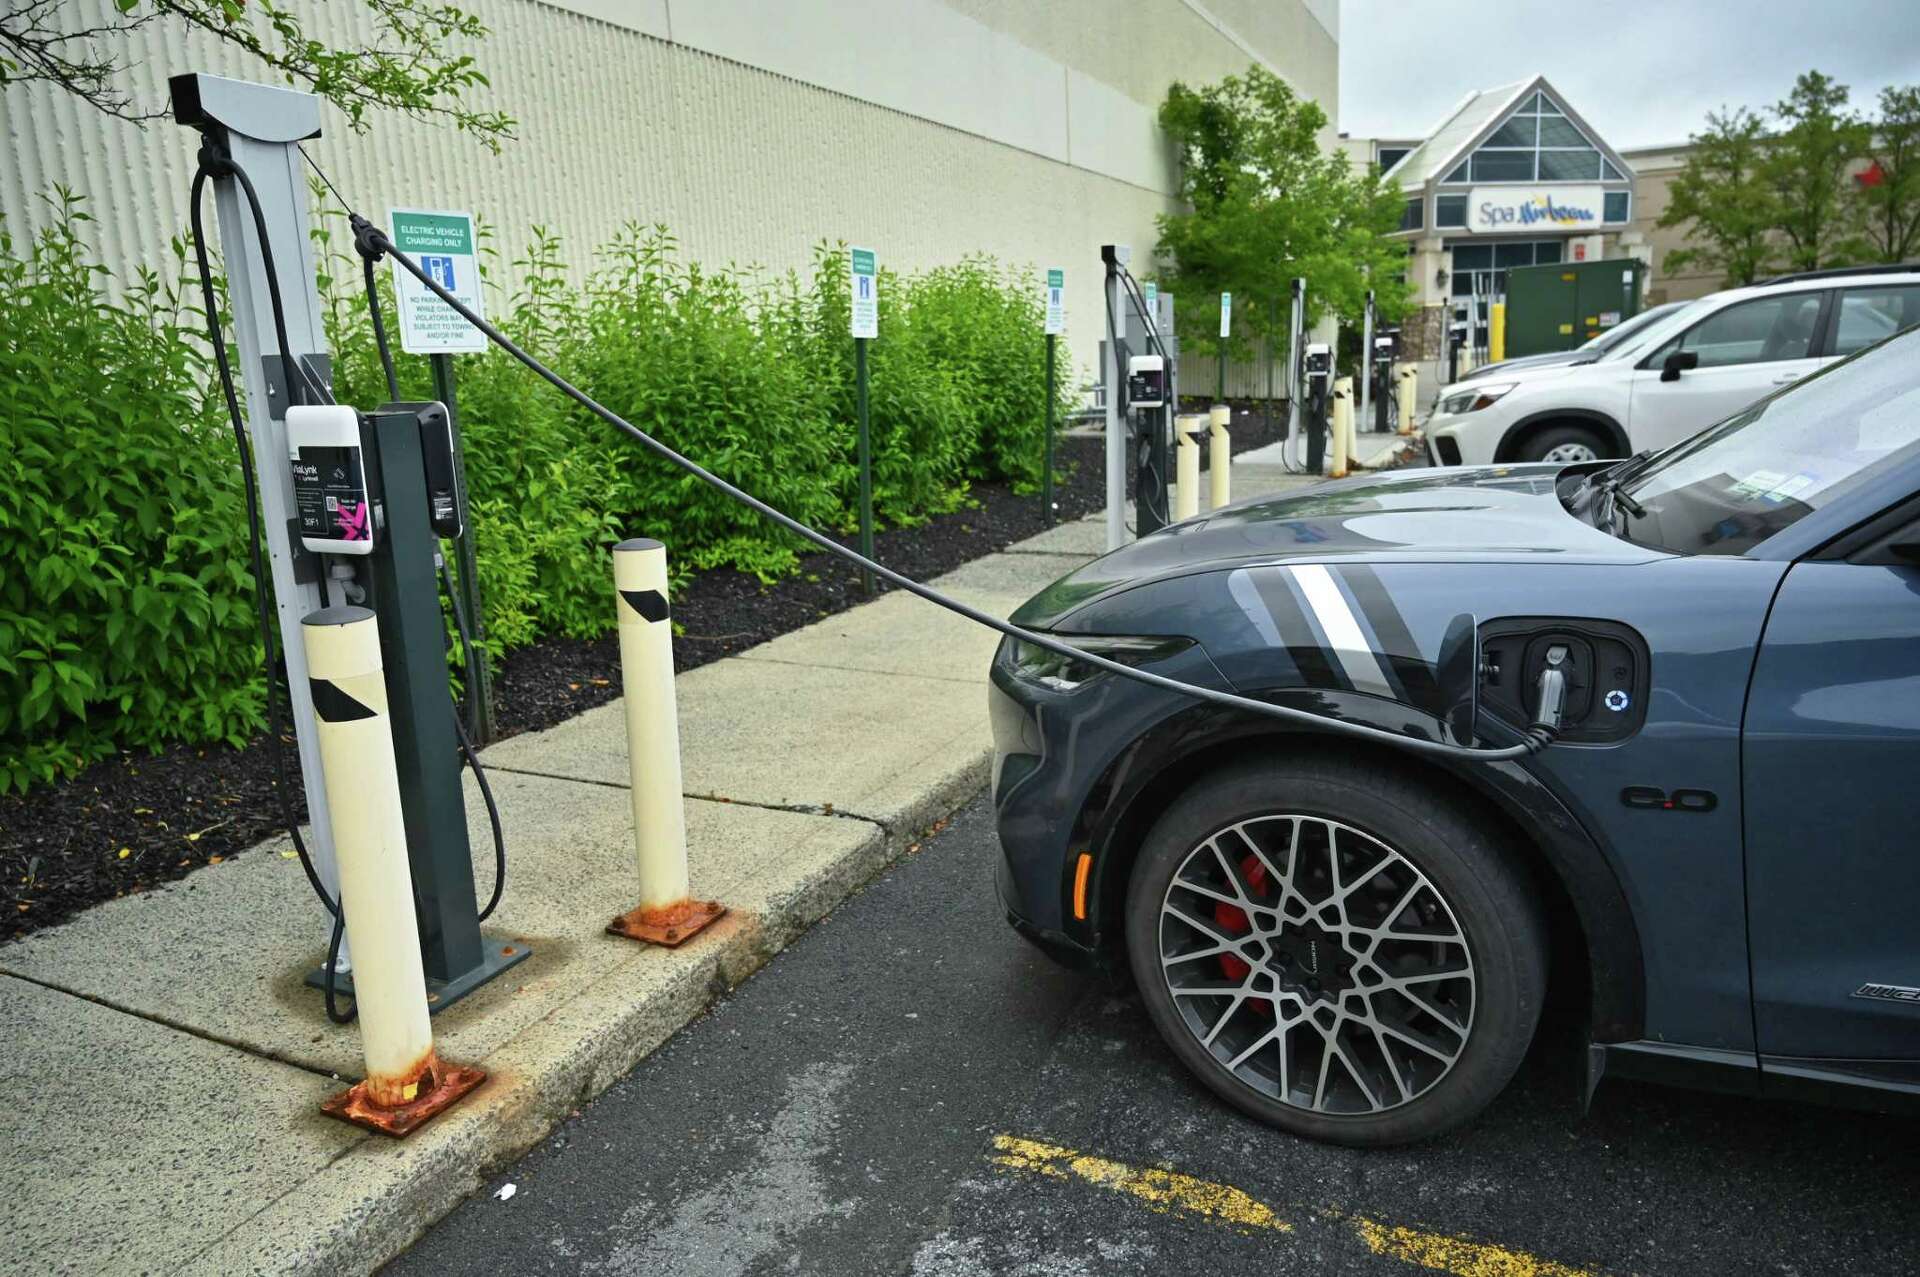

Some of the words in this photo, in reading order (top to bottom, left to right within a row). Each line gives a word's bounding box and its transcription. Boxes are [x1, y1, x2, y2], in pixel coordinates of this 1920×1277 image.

[1479, 202, 1514, 225] Spa
[401, 225, 434, 235] ELECTRIC
[435, 227, 464, 237] VEHICLE
[406, 236, 443, 246] CHARGING
[444, 239, 462, 247] ONLY
[414, 313, 448, 321] VIOLATORS
[427, 331, 449, 339] AND/OR
[450, 331, 464, 339] FINE
